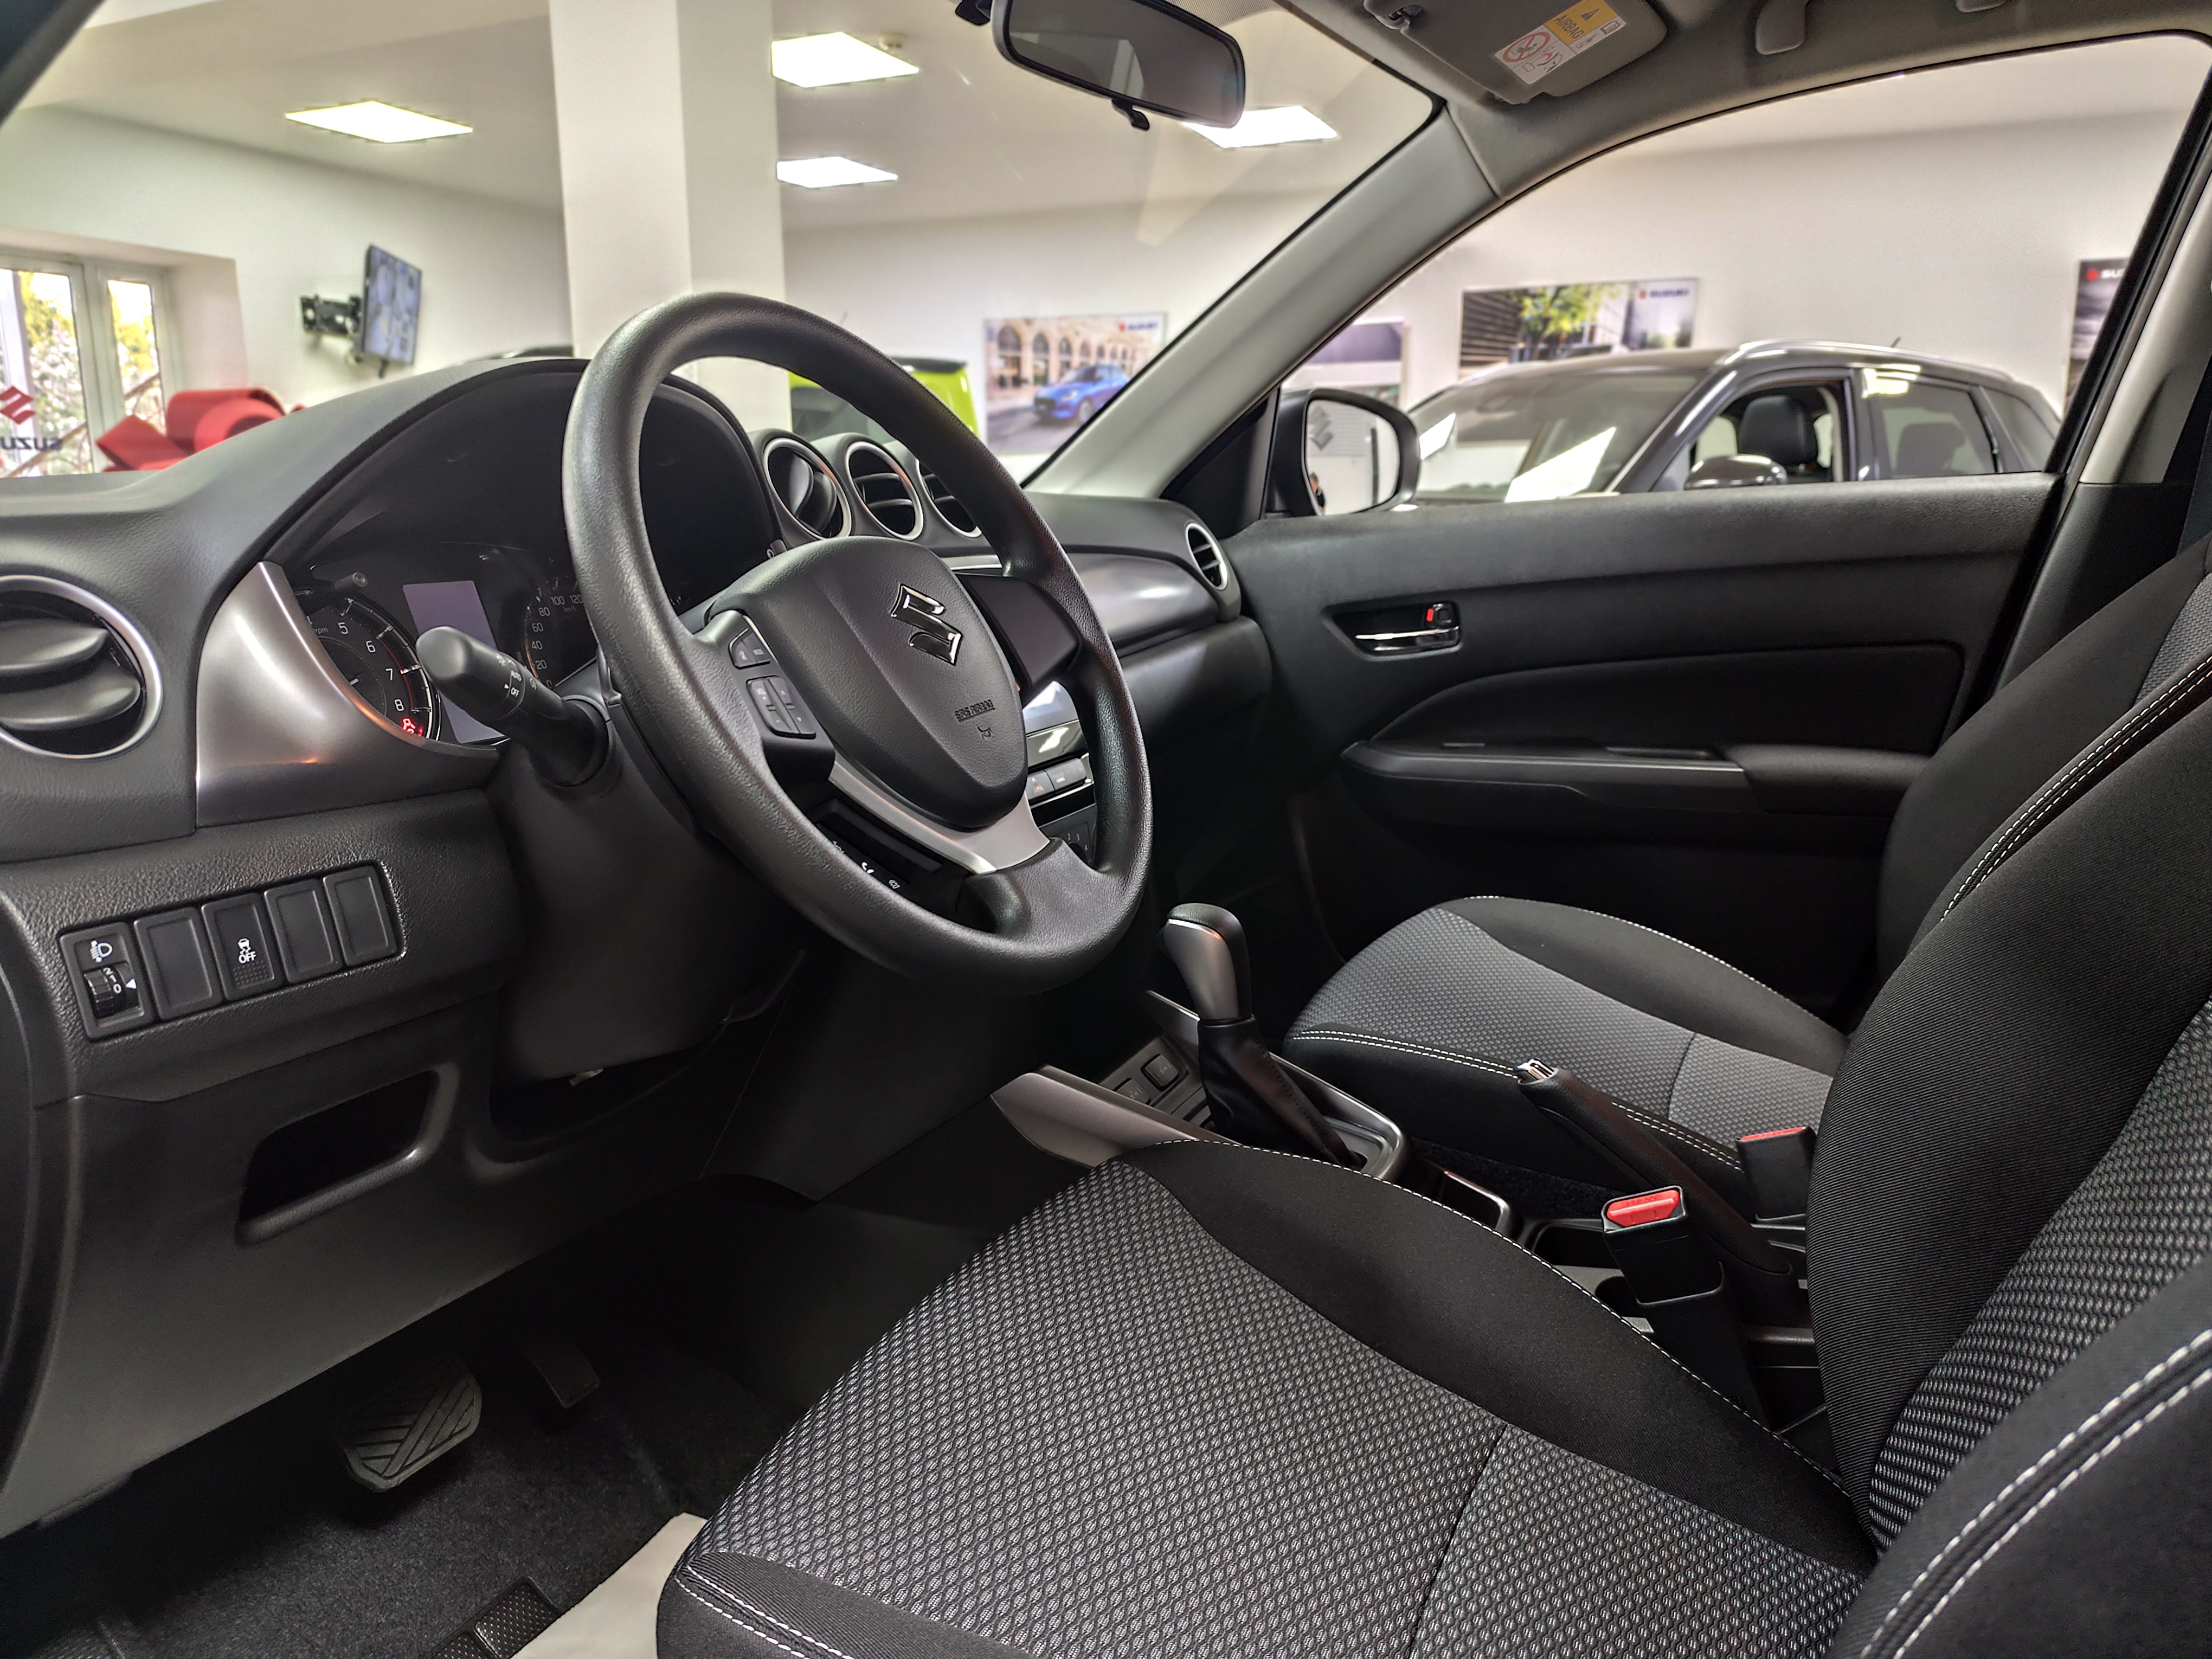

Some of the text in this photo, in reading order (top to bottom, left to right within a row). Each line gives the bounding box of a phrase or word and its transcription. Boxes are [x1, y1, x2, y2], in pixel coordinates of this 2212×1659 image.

[1554, 15, 1584, 39] AIRBAG
[551, 596, 565, 606] 100
[569, 594, 583, 604] 120
[538, 607, 550, 616] 80
[338, 622, 348, 634] 5
[532, 622, 544, 632] 60
[365, 640, 376, 653] 6
[532, 640, 543, 650] 40
[535, 659, 547, 670] 20
[385, 668, 393, 680] 7
[510, 687, 520, 698] OFF
[394, 699, 404, 711] 8
[239, 951, 256, 964] OFF
[102, 967, 113, 975] 2
[110, 974, 117, 983] 1
[113, 983, 122, 994] 0
